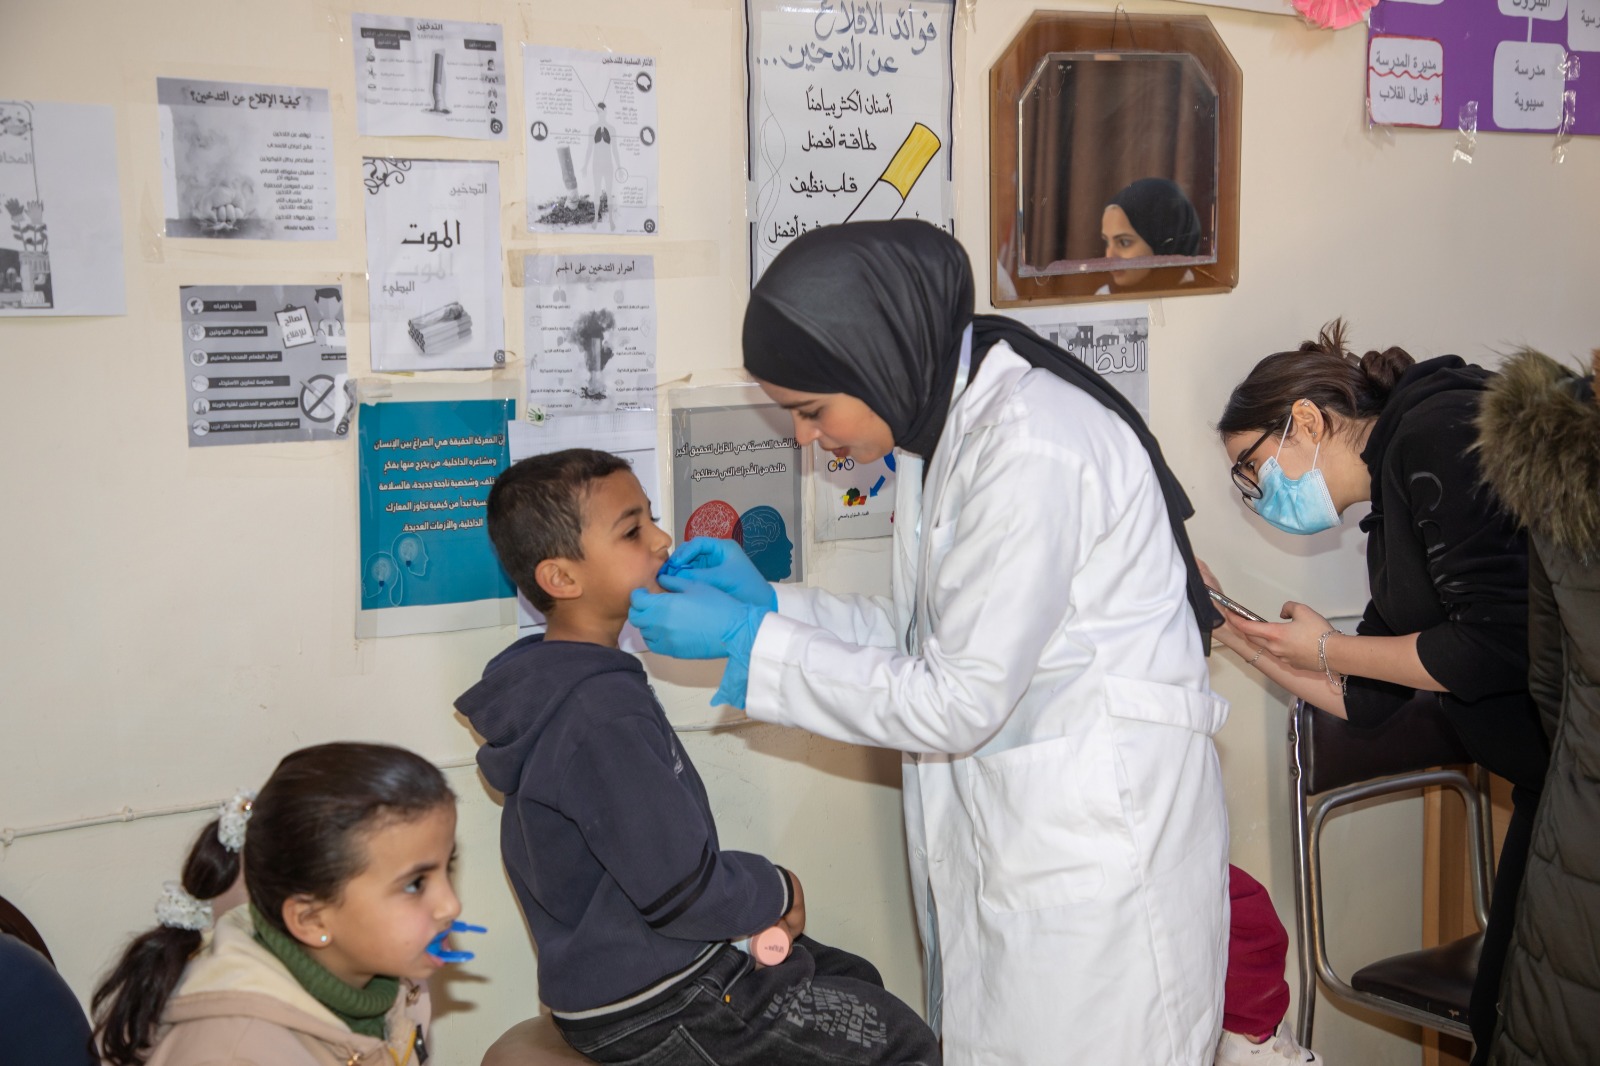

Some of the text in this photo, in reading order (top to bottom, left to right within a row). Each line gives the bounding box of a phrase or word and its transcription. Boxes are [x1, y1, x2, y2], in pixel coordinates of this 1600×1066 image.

[417, 22, 443, 31] التدخين
[866, 49, 898, 77] عن
[1376, 52, 1437, 73] مديرة المدرسة
[1514, 59, 1546, 80] مدرسة
[232, 95, 245, 106] عن
[249, 93, 277, 109] الإقلاع
[280, 95, 301, 109] كيفية
[864, 93, 893, 114] أسنان
[801, 125, 877, 152] طاقة أفضل
[449, 183, 487, 196] التدخين
[790, 171, 858, 198] قلب نظيف
[401, 219, 461, 252] الموت
[575, 262, 587, 275] على
[588, 263, 615, 275] التدخين
[617, 260, 635, 275] أضرار
[382, 281, 415, 297] البطيء
[284, 314, 303, 327] نصائح
[374, 439, 400, 451] الإنسان
[400, 441, 412, 449] بين
[434, 440, 448, 449] هي
[449, 437, 474, 448] الحقيقة
[475, 436, 498, 447] المعركة
[675, 442, 689, 457] أكبر
[690, 445, 713, 457] لتحقيق
[734, 443, 747, 455] هي
[400, 460, 414, 472] منها
[415, 460, 430, 470] يخرج
[430, 461, 441, 469] من
[469, 457, 497, 467] ومشاعره
[769, 463, 786, 473] فائدة
[720, 467, 735, 481] التي
[760, 466, 769, 475] من
[379, 481, 411, 491] فالسلامة
[433, 479, 450, 489] ناجحة
[451, 478, 479, 488] وشخصية
[386, 502, 412, 513] المعارك
[413, 501, 429, 512] تجاوز
[430, 500, 448, 510] كيفية
[449, 502, 459, 510] من
[459, 497, 472, 508] تبدأ
[430, 519, 458, 531] والأزمات
